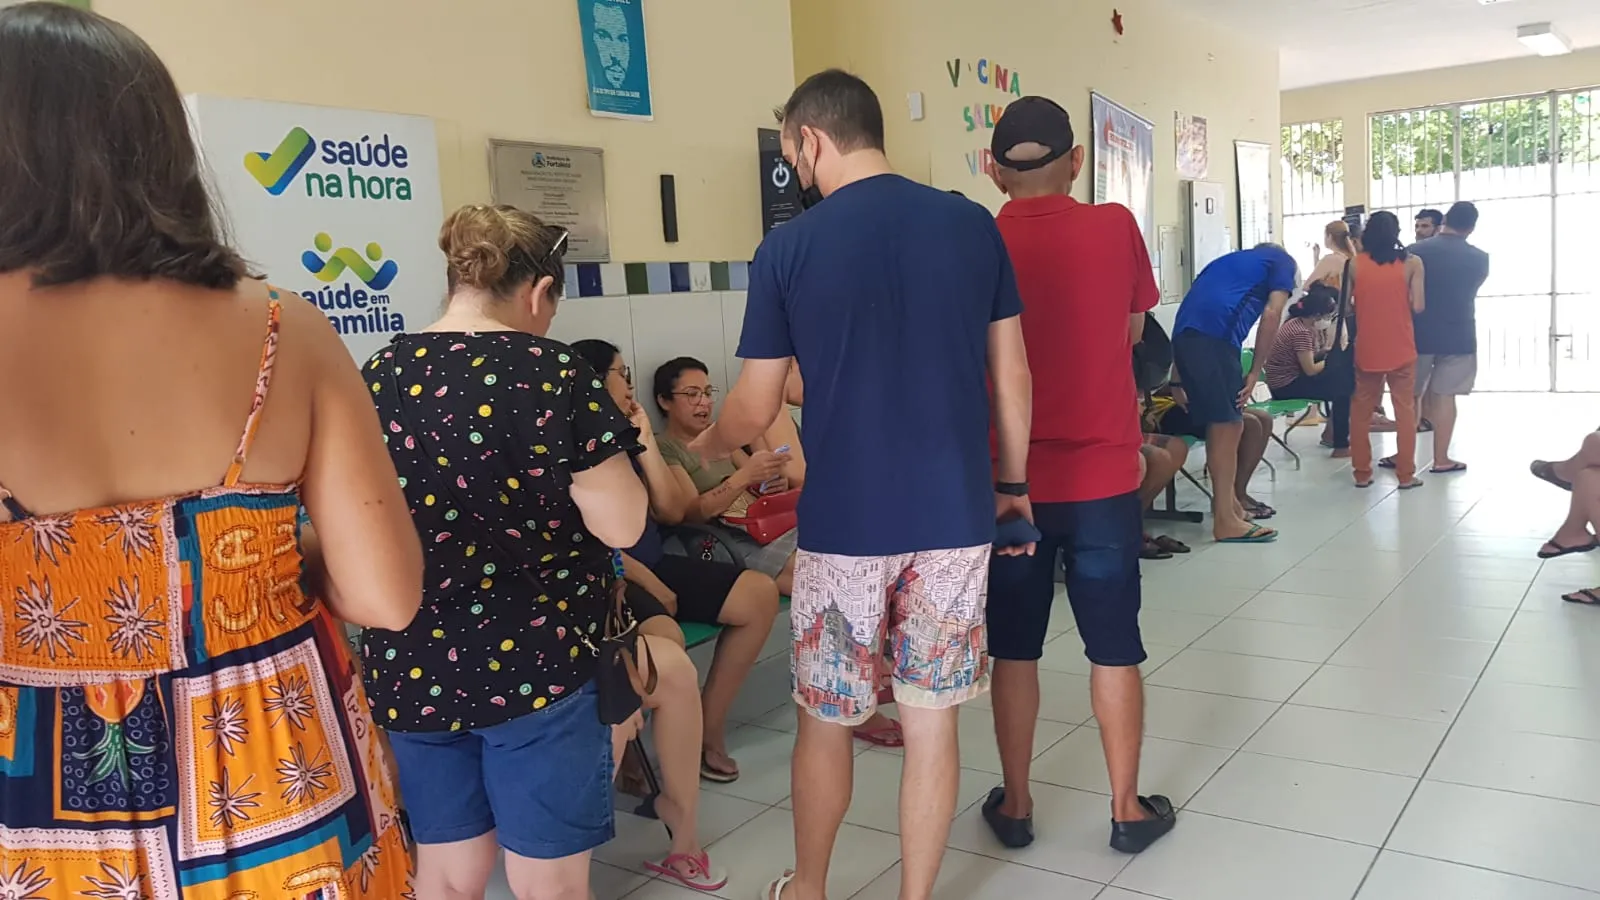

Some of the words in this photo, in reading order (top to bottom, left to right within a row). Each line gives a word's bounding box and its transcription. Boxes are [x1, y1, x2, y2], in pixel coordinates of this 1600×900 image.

[946, 58, 1021, 97] VCINA
[963, 104, 1003, 132] SALV
[321, 133, 408, 168] saúde
[305, 172, 343, 198] na
[348, 166, 412, 201] hora
[302, 283, 368, 310] aúde
[370, 294, 390, 304] em
[328, 306, 404, 334] amília
